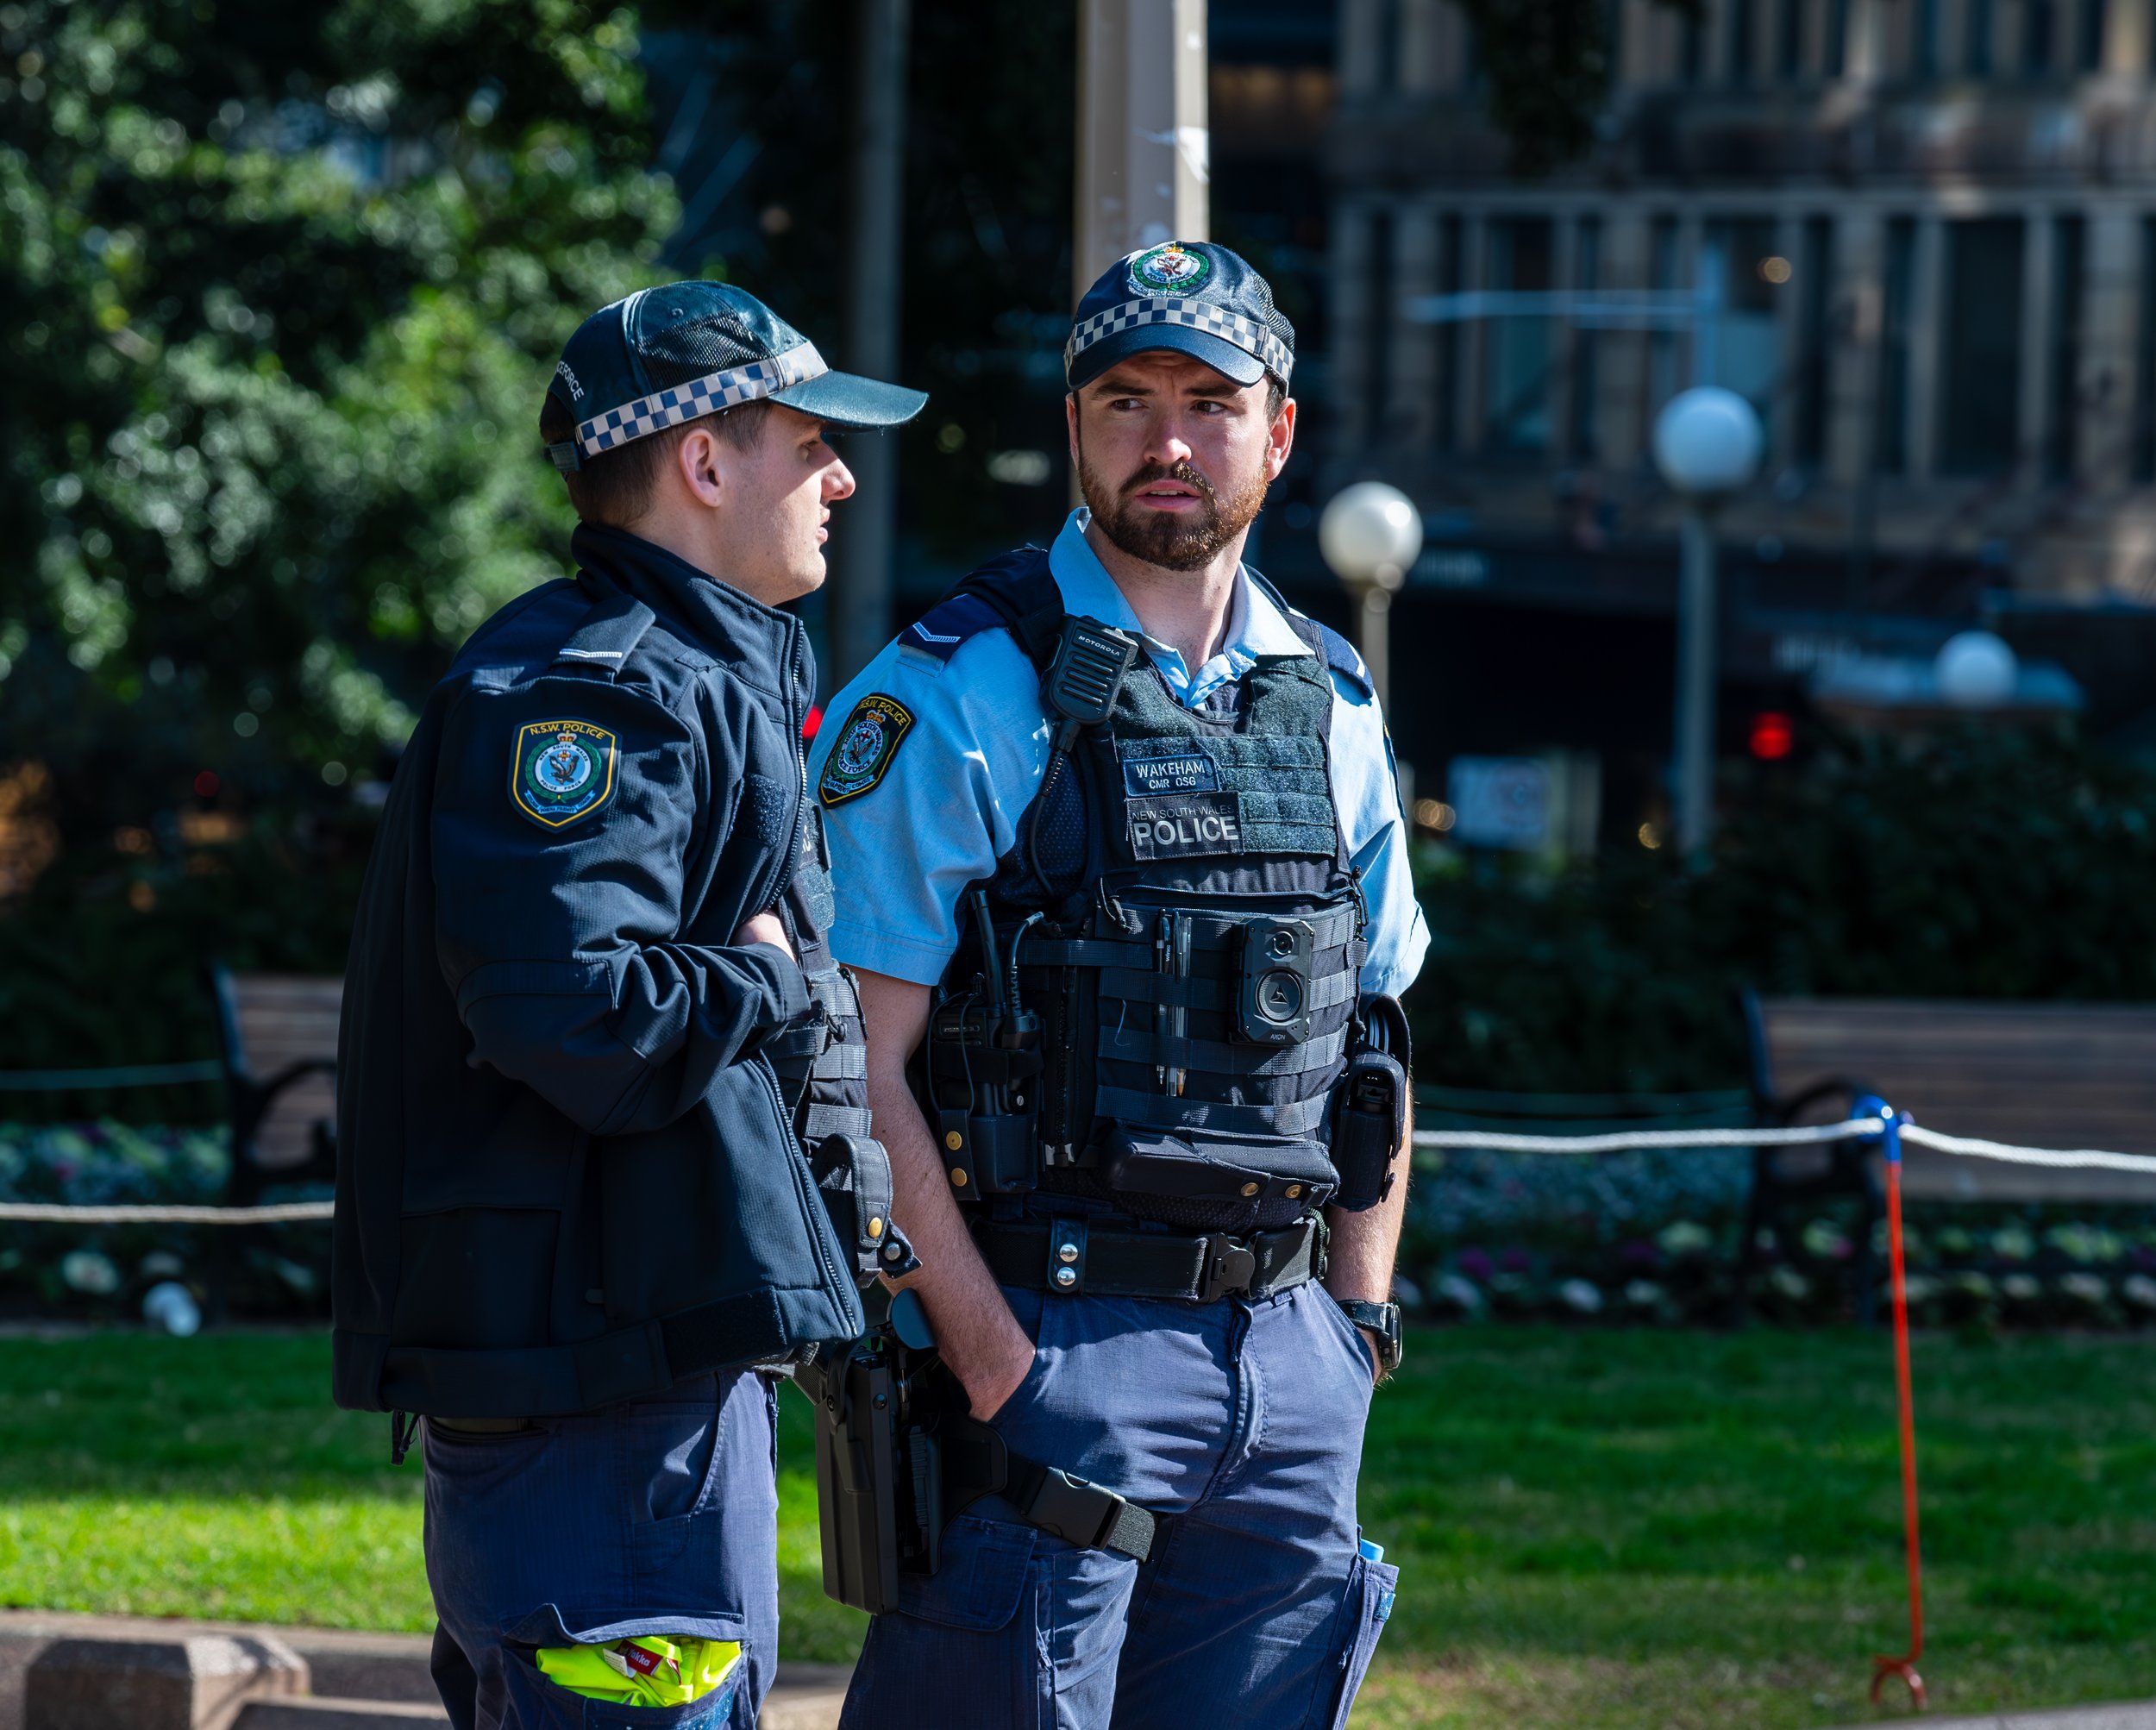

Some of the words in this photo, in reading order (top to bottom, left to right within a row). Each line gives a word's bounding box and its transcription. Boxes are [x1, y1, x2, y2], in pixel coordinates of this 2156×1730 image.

[561, 363, 584, 401] FORCE
[1078, 636, 1119, 655] MOTOROLA
[878, 702, 906, 726] POLICE
[530, 724, 560, 736] N.S.W.
[563, 724, 605, 740] POLICE
[857, 723, 878, 733] SOUTH
[540, 751, 548, 761] NEW
[575, 748, 588, 762] WALES
[848, 759, 871, 772] FORCE
[1136, 762, 1206, 778] WAKEHAM
[541, 780, 557, 790] POLICE
[564, 780, 581, 790] FORCE
[1149, 779, 1169, 789] CMR
[1175, 777, 1196, 787] OSG
[1131, 810, 1156, 820] NEW
[1159, 807, 1196, 818] SOUTH
[1198, 805, 1234, 816] WALES
[1133, 816, 1238, 847] POLICE
